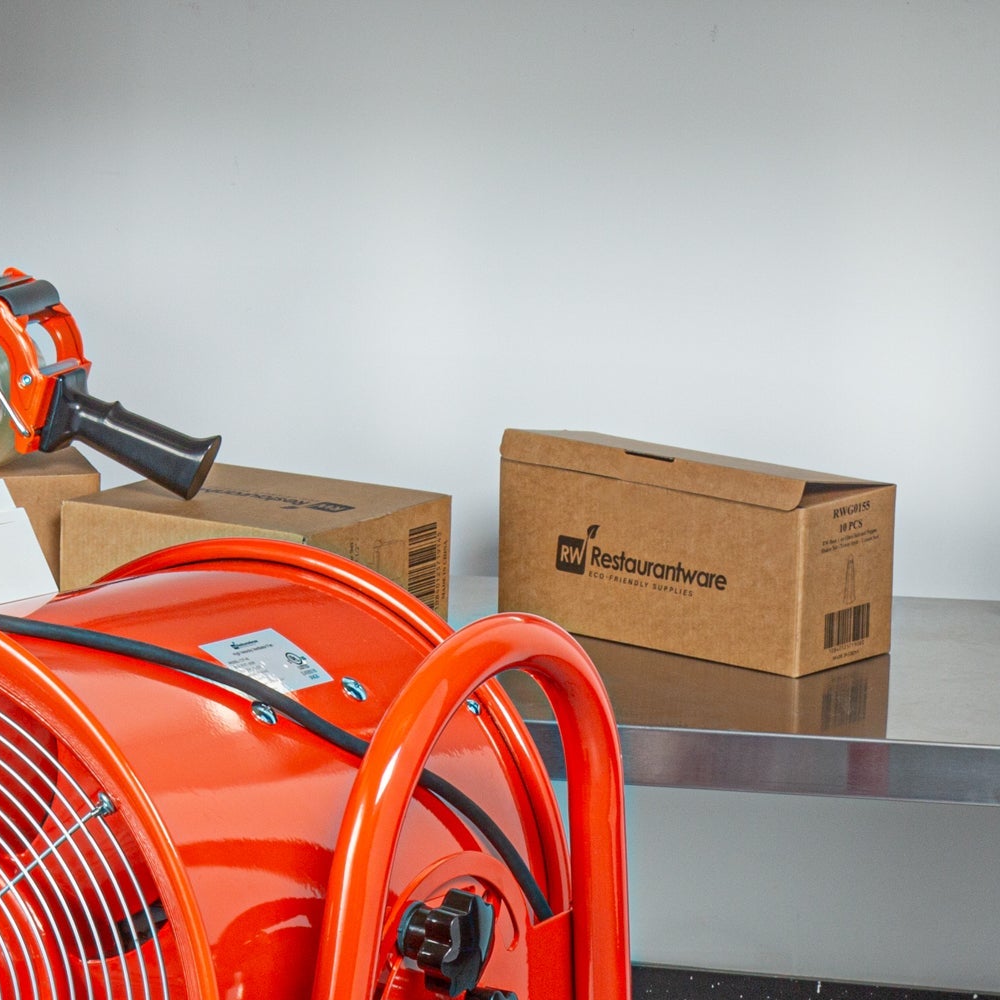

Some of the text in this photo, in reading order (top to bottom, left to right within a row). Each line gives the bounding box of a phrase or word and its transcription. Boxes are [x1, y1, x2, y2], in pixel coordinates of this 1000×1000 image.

[833, 500, 871, 519] RWG0155
[848, 519, 863, 531] PCS
[560, 544, 728, 591] RW Restaurantware
[588, 570, 694, 597] ECO-FRIENDLY SUPPLIES
